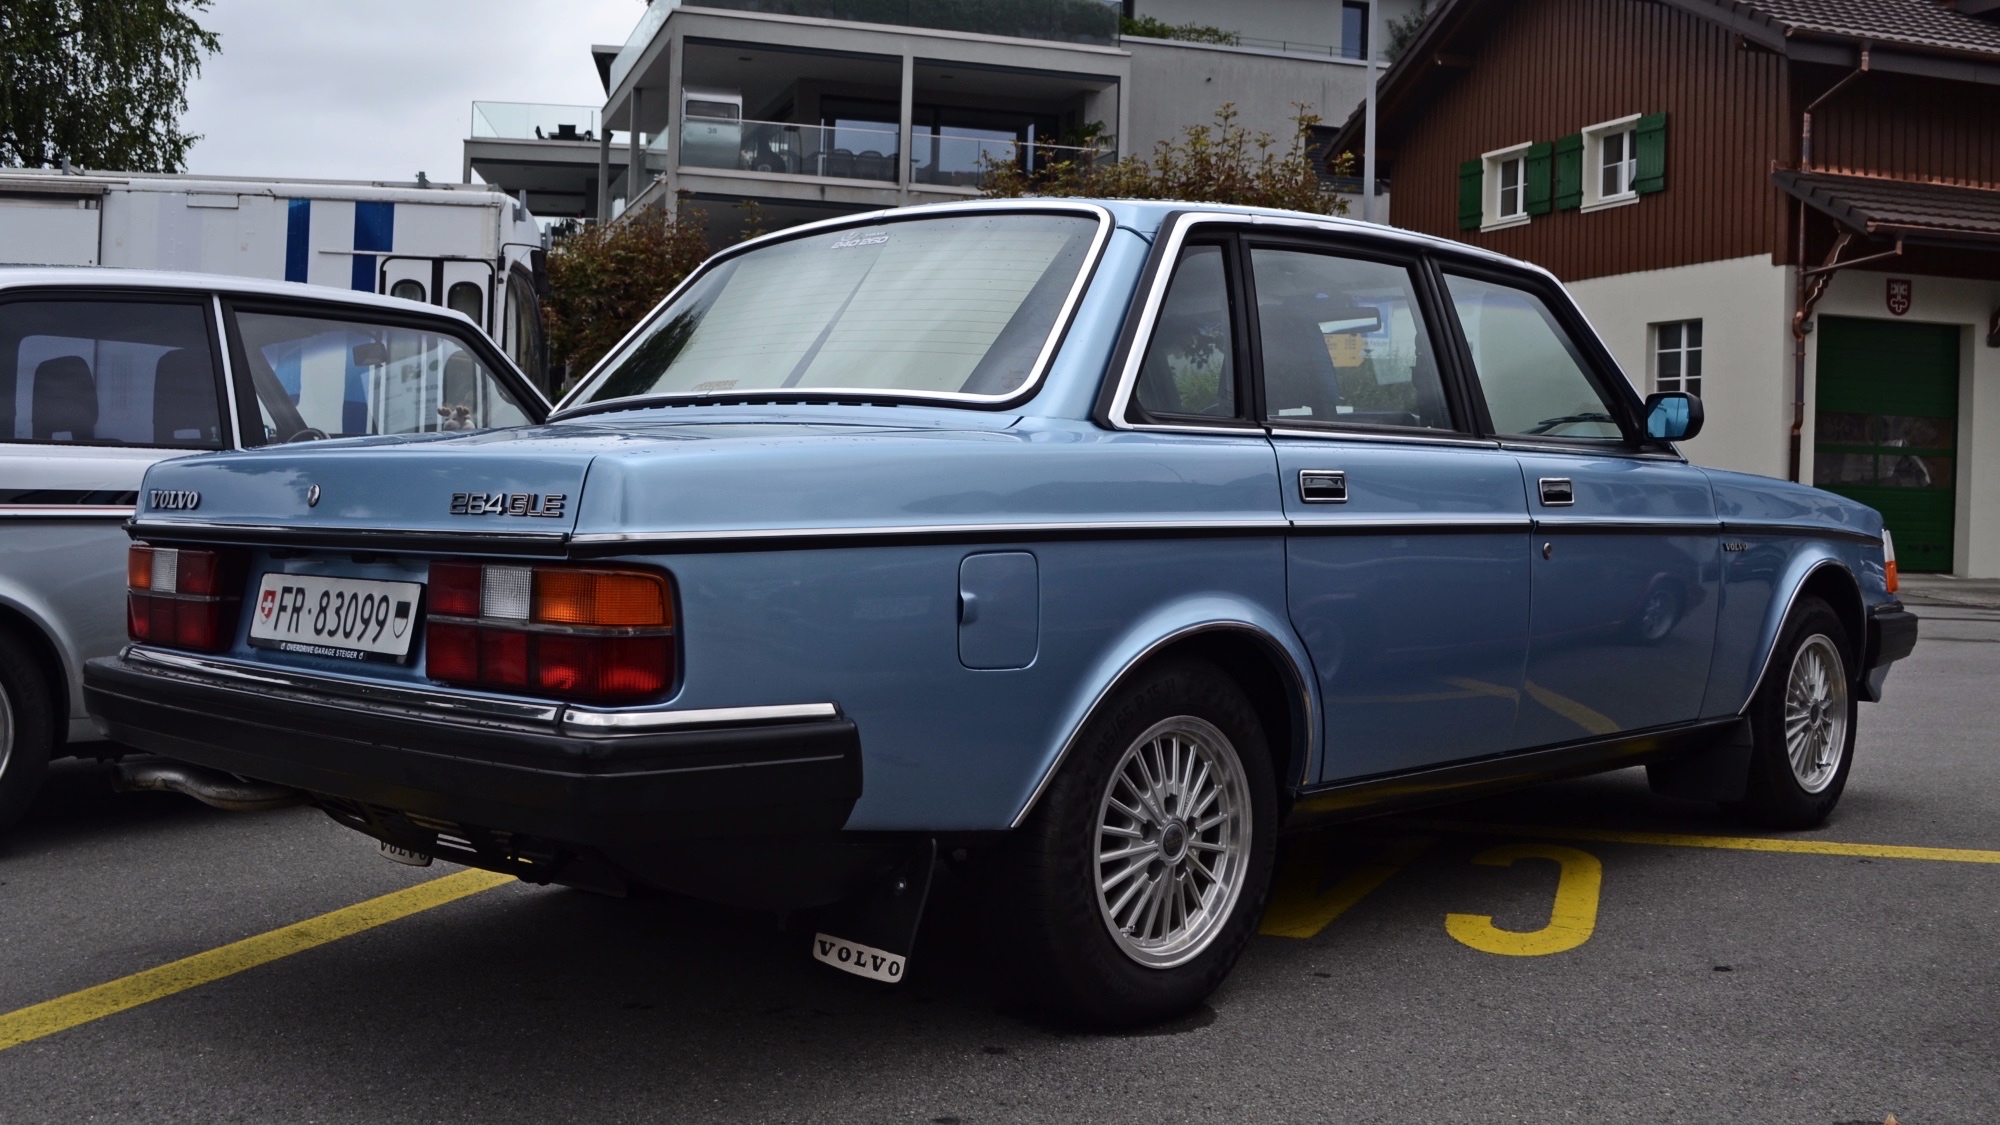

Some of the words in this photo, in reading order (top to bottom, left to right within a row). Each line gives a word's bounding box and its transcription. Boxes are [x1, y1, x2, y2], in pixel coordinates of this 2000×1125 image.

[707, 127, 718, 135] 38
[150, 490, 200, 509] VOLVO
[1723, 542, 1749, 552] VOLVO
[286, 643, 315, 654] OVERDRIVE
[314, 646, 336, 657] GARAGE
[335, 649, 358, 659] STEIGER
[817, 939, 901, 977] VOLVO
